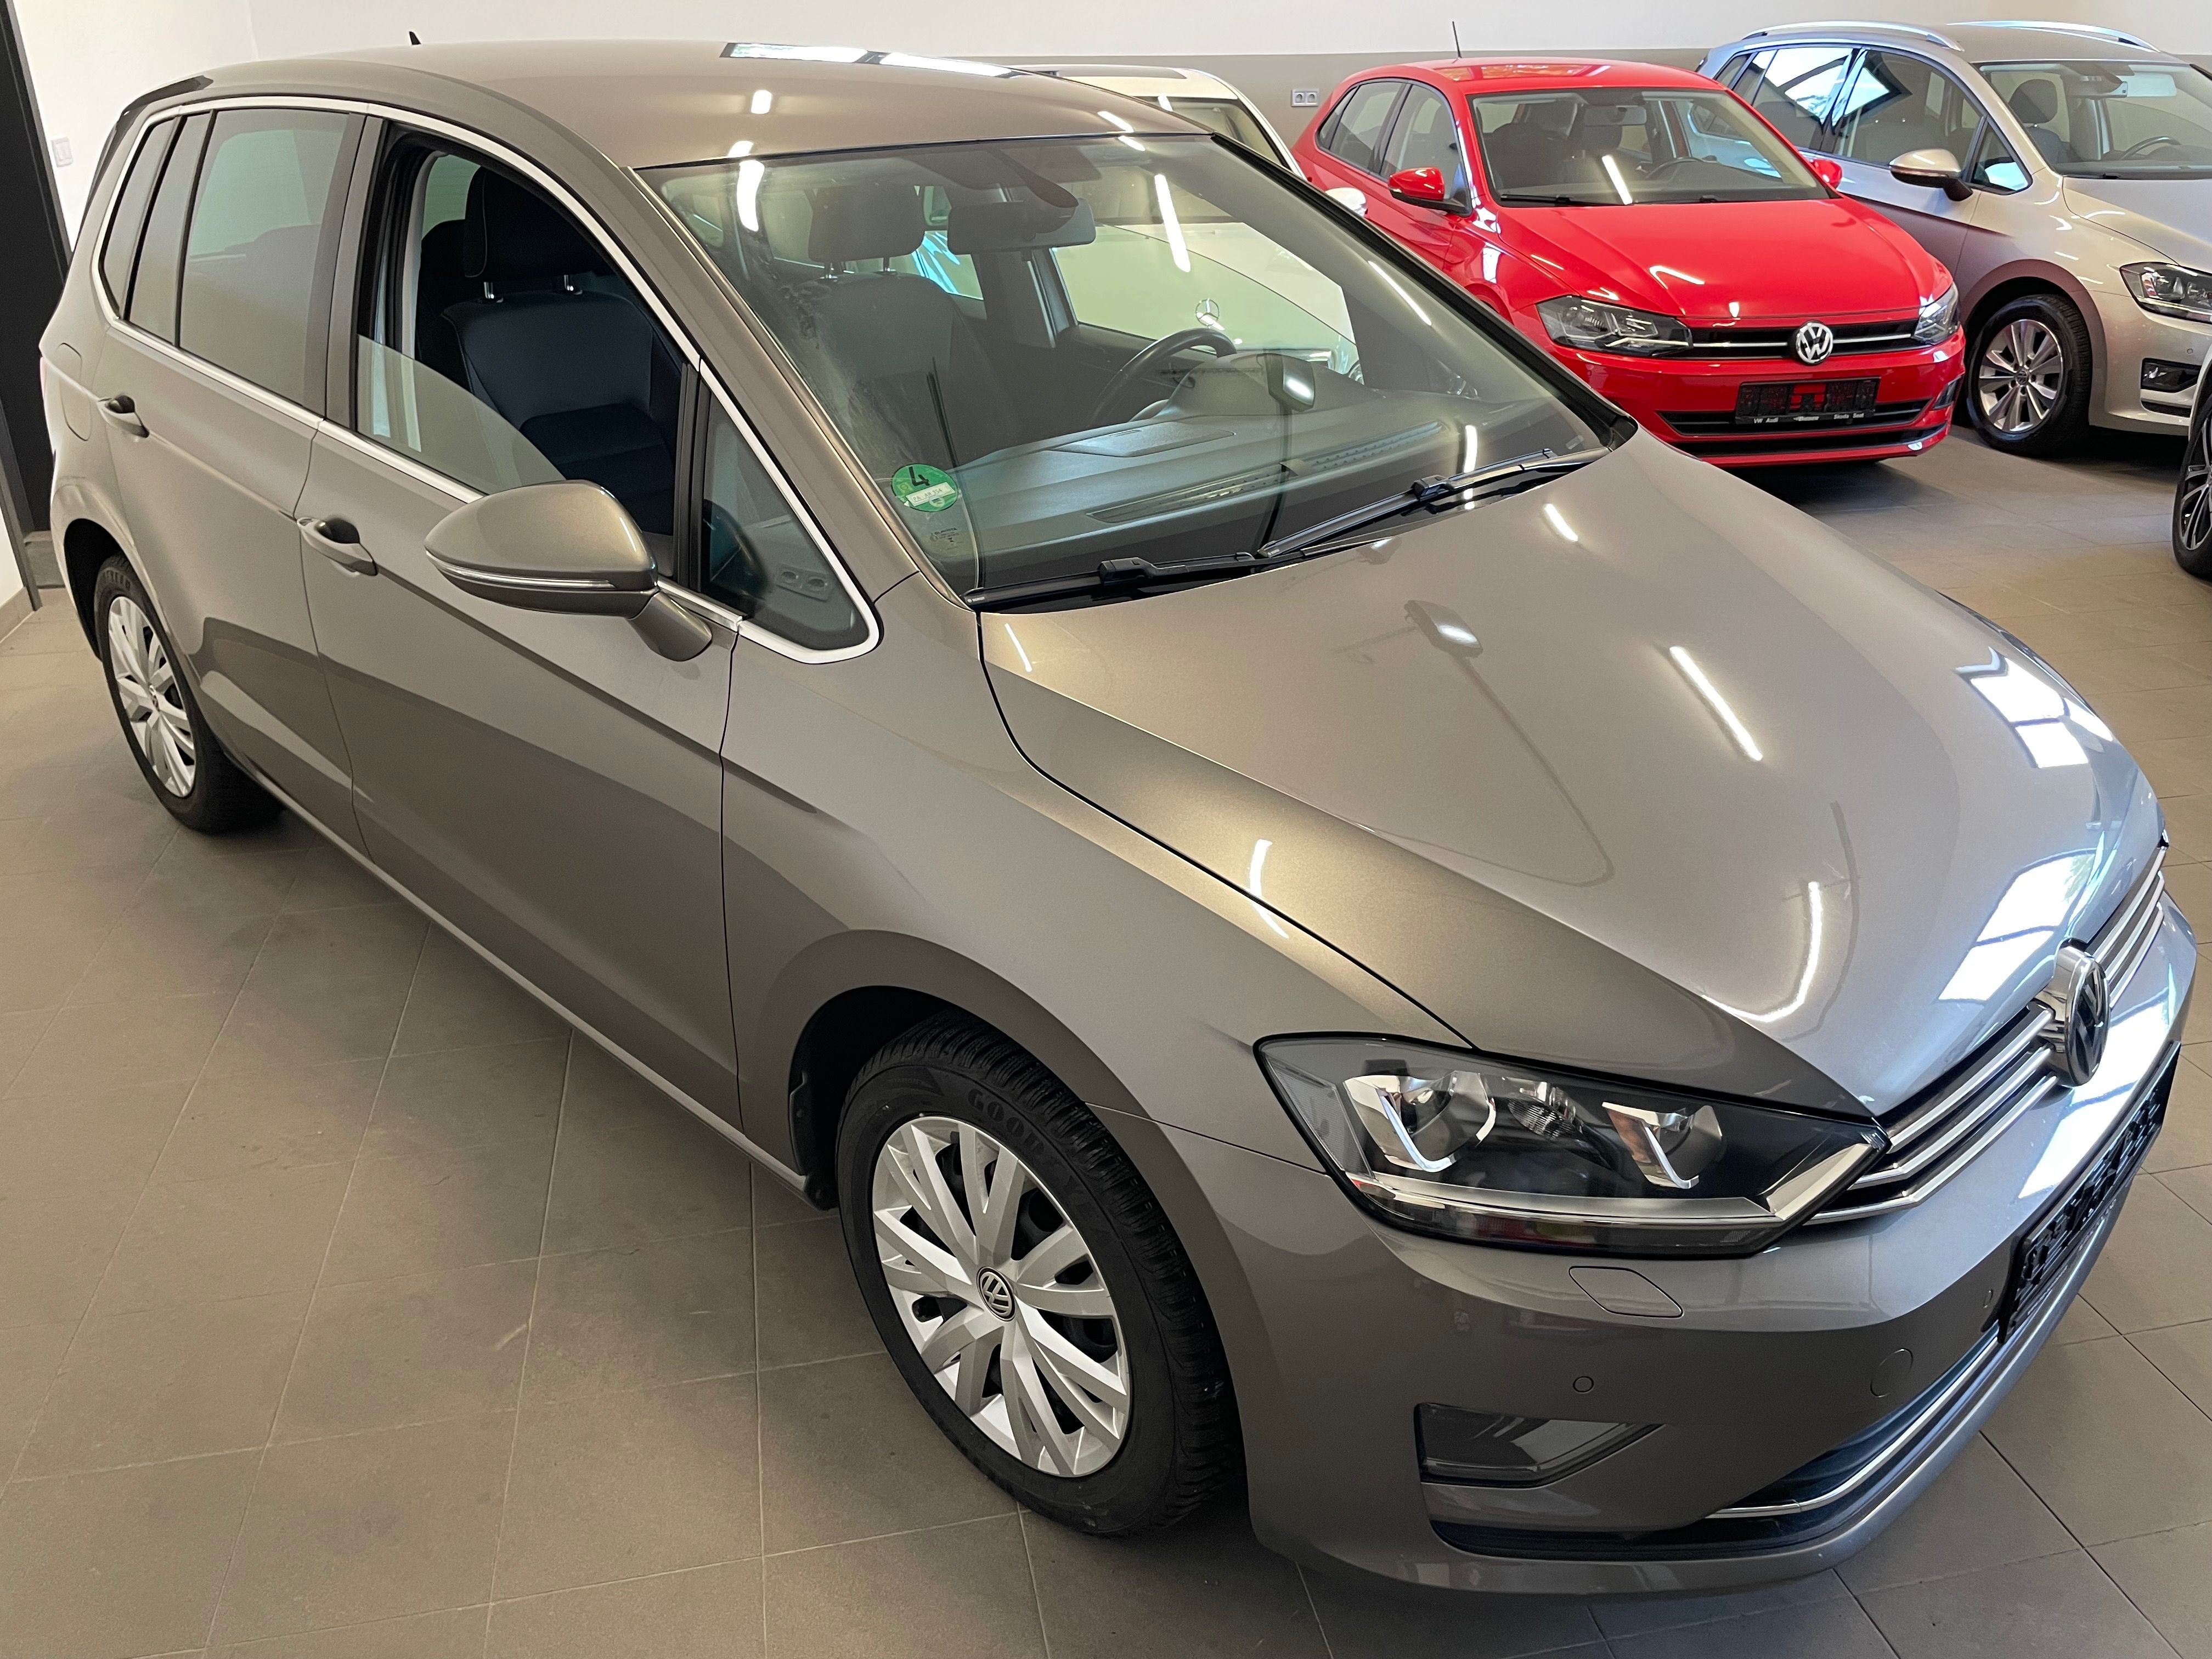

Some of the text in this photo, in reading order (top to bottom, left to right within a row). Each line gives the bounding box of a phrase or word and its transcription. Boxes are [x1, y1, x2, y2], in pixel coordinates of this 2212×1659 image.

[1796, 323, 1833, 363] VW
[909, 466, 930, 486] 4
[979, 1271, 1013, 1317] VW
